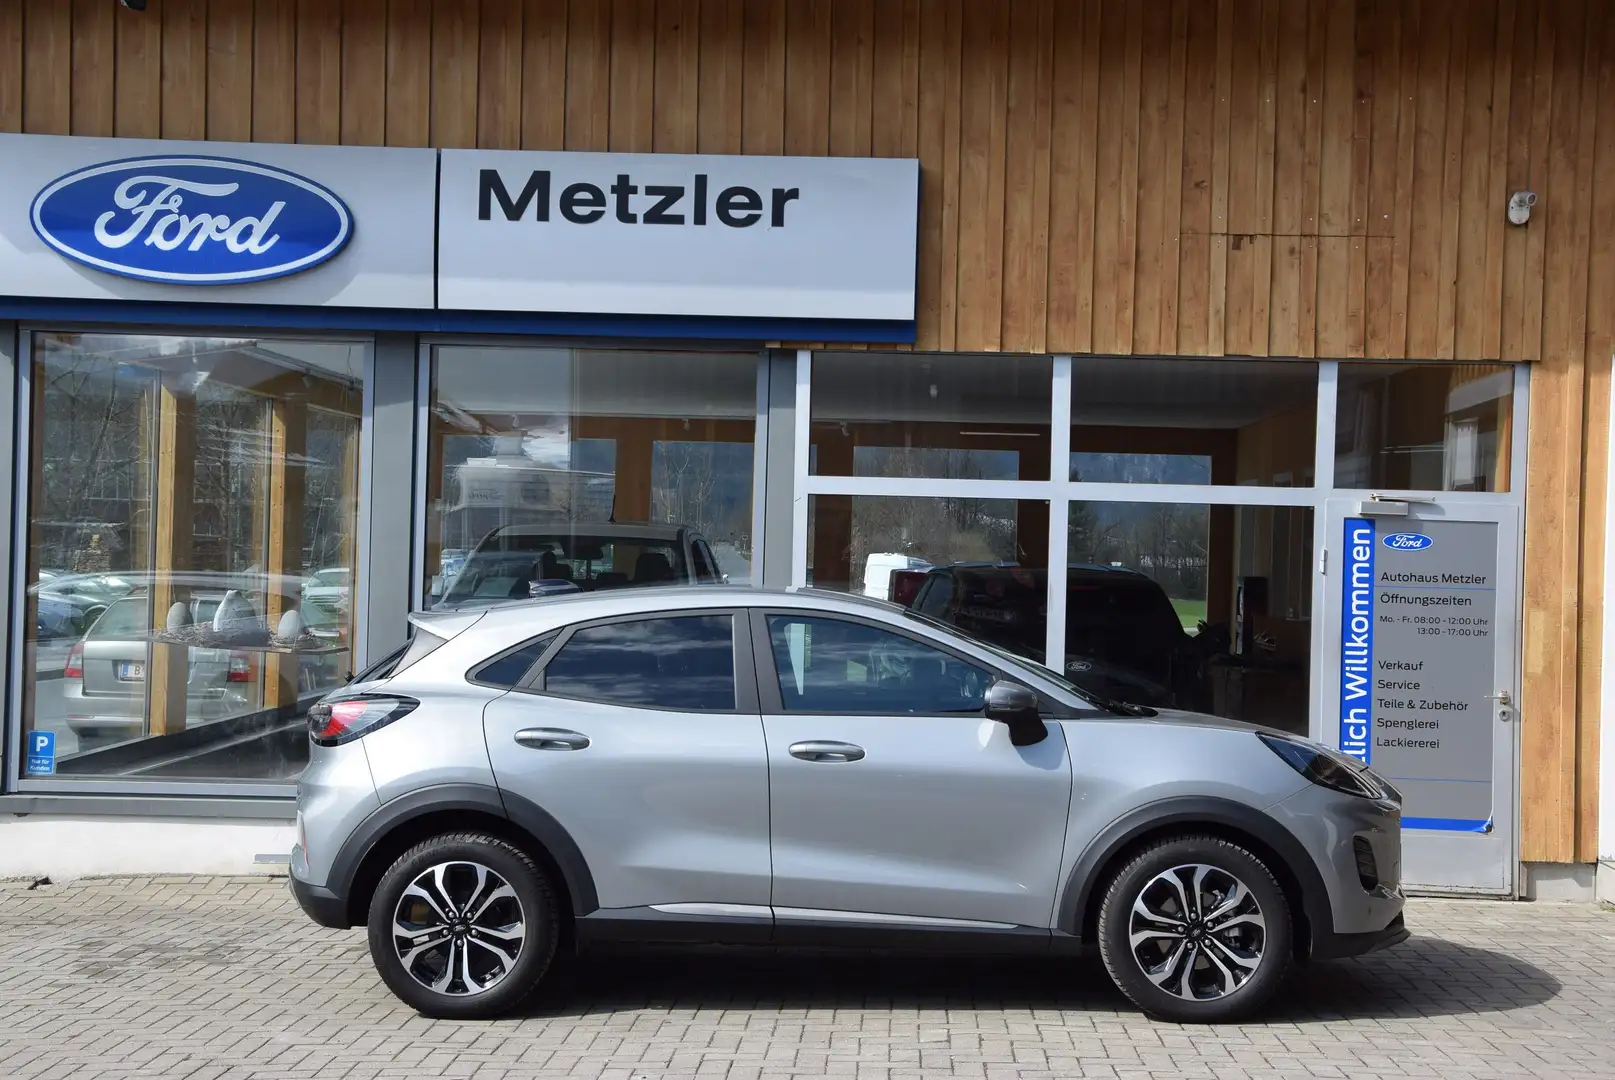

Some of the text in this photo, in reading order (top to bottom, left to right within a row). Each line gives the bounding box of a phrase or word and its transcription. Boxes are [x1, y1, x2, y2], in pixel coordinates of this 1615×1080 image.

[478, 169, 799, 228] Metzler
[93, 174, 287, 255] Ford
[1392, 534, 1423, 548] Ford
[1380, 572, 1487, 584] Autohaus Metzler
[1380, 592, 1472, 607] Öffnungszeiten
[1379, 615, 1395, 623] Mo.
[1413, 616, 1441, 624] 08:00
[1447, 617, 1472, 625] 12:00
[1473, 618, 1488, 626] Uhr
[1417, 627, 1441, 635] 13:00
[1447, 628, 1471, 636] 17:00
[1343, 529, 1371, 763] lich Willkommen
[1378, 660, 1423, 671] Verkauf
[1377, 679, 1421, 690] Service
[1377, 698, 1468, 711] Teile & Zubehör
[1377, 717, 1439, 731] Spenglerei
[36, 735, 49, 752] P
[1376, 737, 1440, 749] Lackiererei
